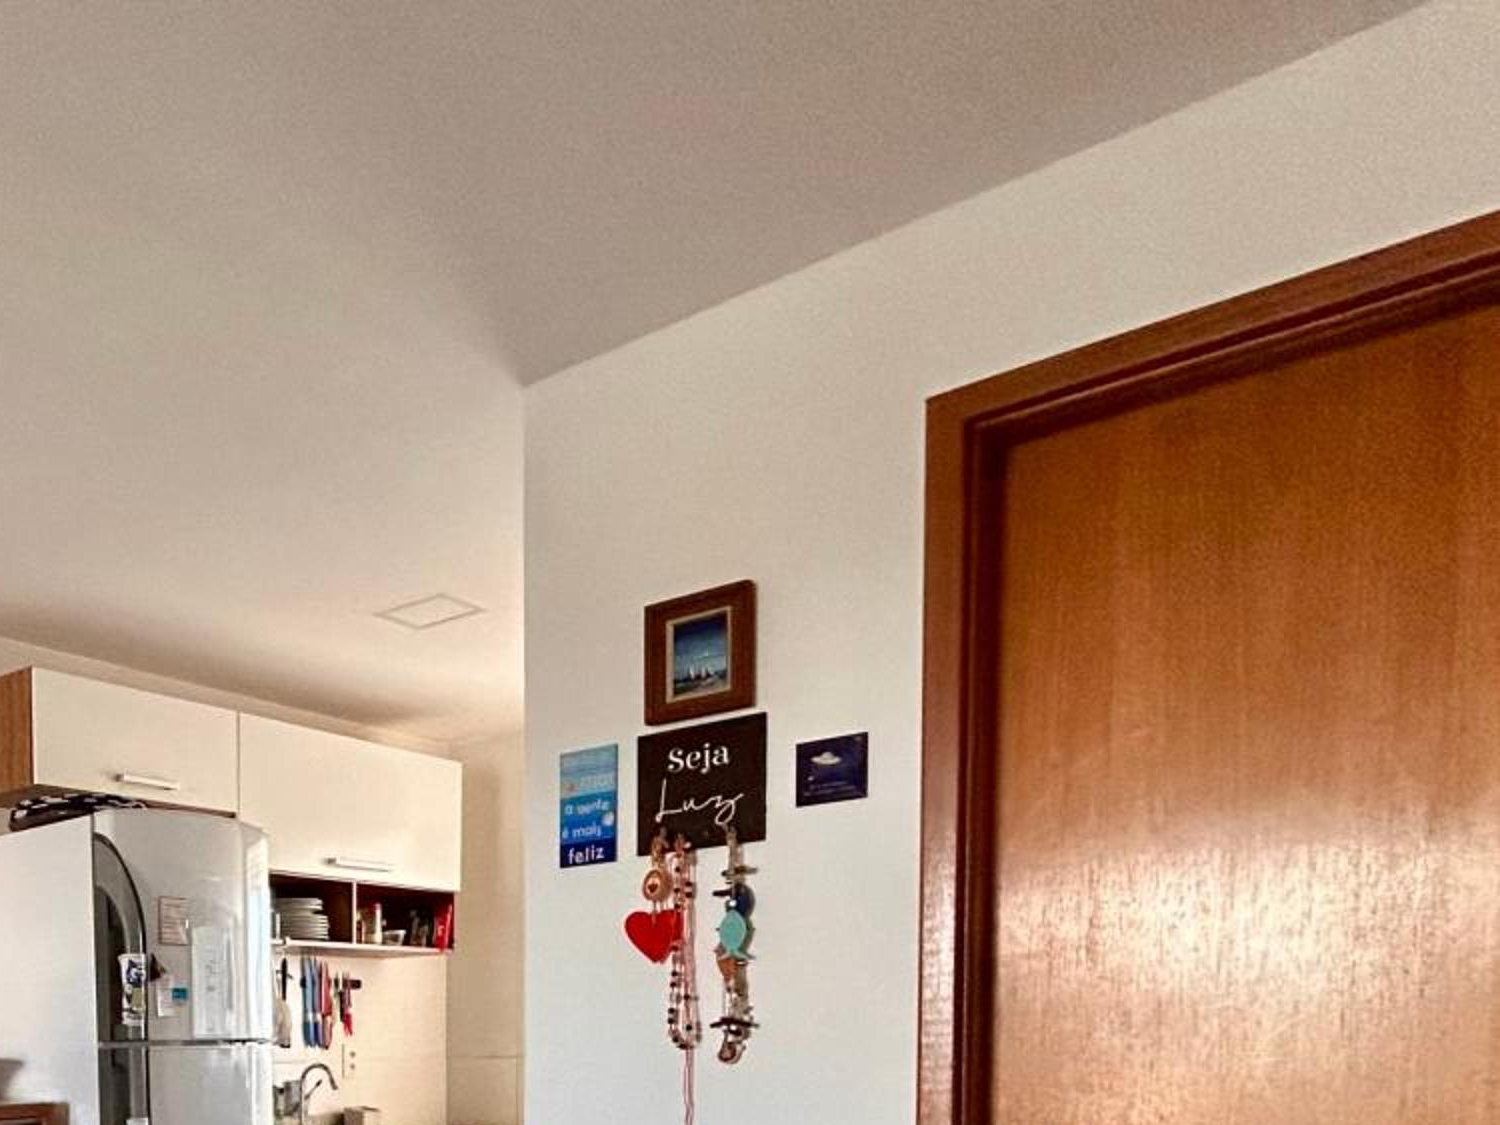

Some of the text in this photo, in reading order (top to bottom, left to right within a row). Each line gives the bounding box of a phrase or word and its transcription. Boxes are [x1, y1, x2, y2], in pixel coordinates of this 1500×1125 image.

[667, 742, 730, 774] Seja
[655, 778, 745, 826] Luz
[568, 844, 605, 865] feliz
